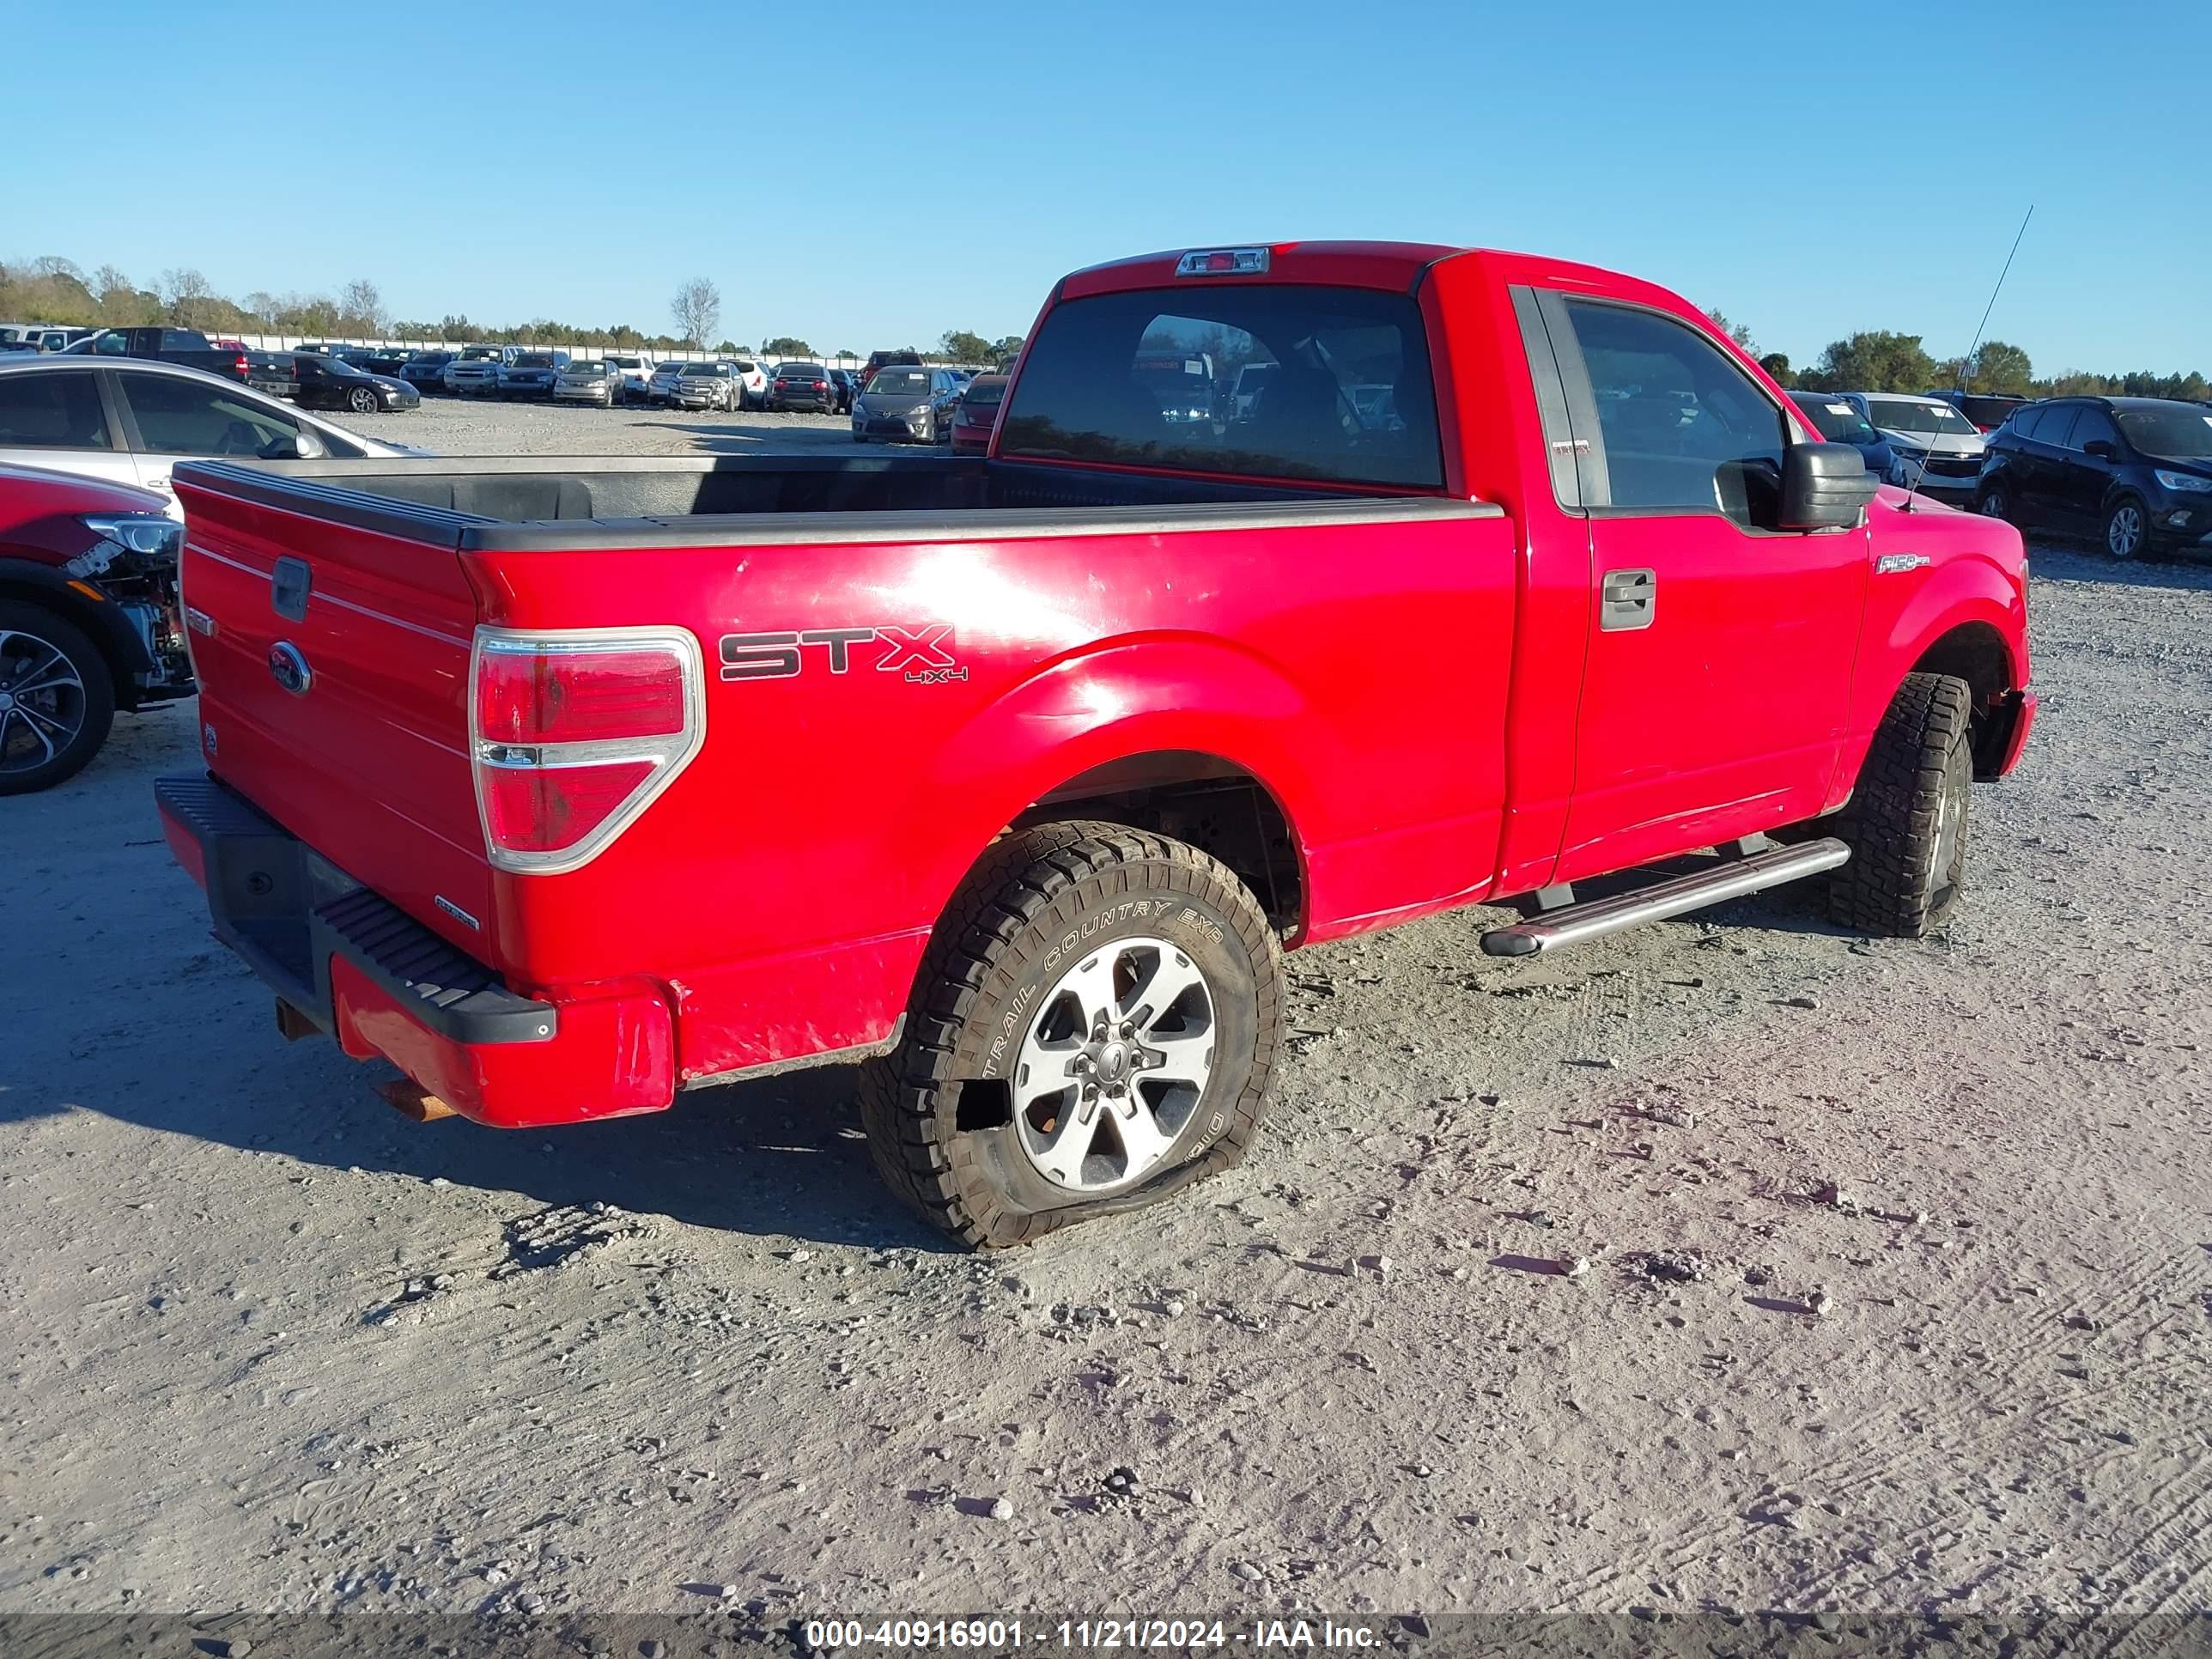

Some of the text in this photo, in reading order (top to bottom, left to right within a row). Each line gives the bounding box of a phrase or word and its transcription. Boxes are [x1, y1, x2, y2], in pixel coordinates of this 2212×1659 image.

[719, 623, 956, 682] STX
[982, 900, 1224, 1078] TRAIL COUNTRY EXP
